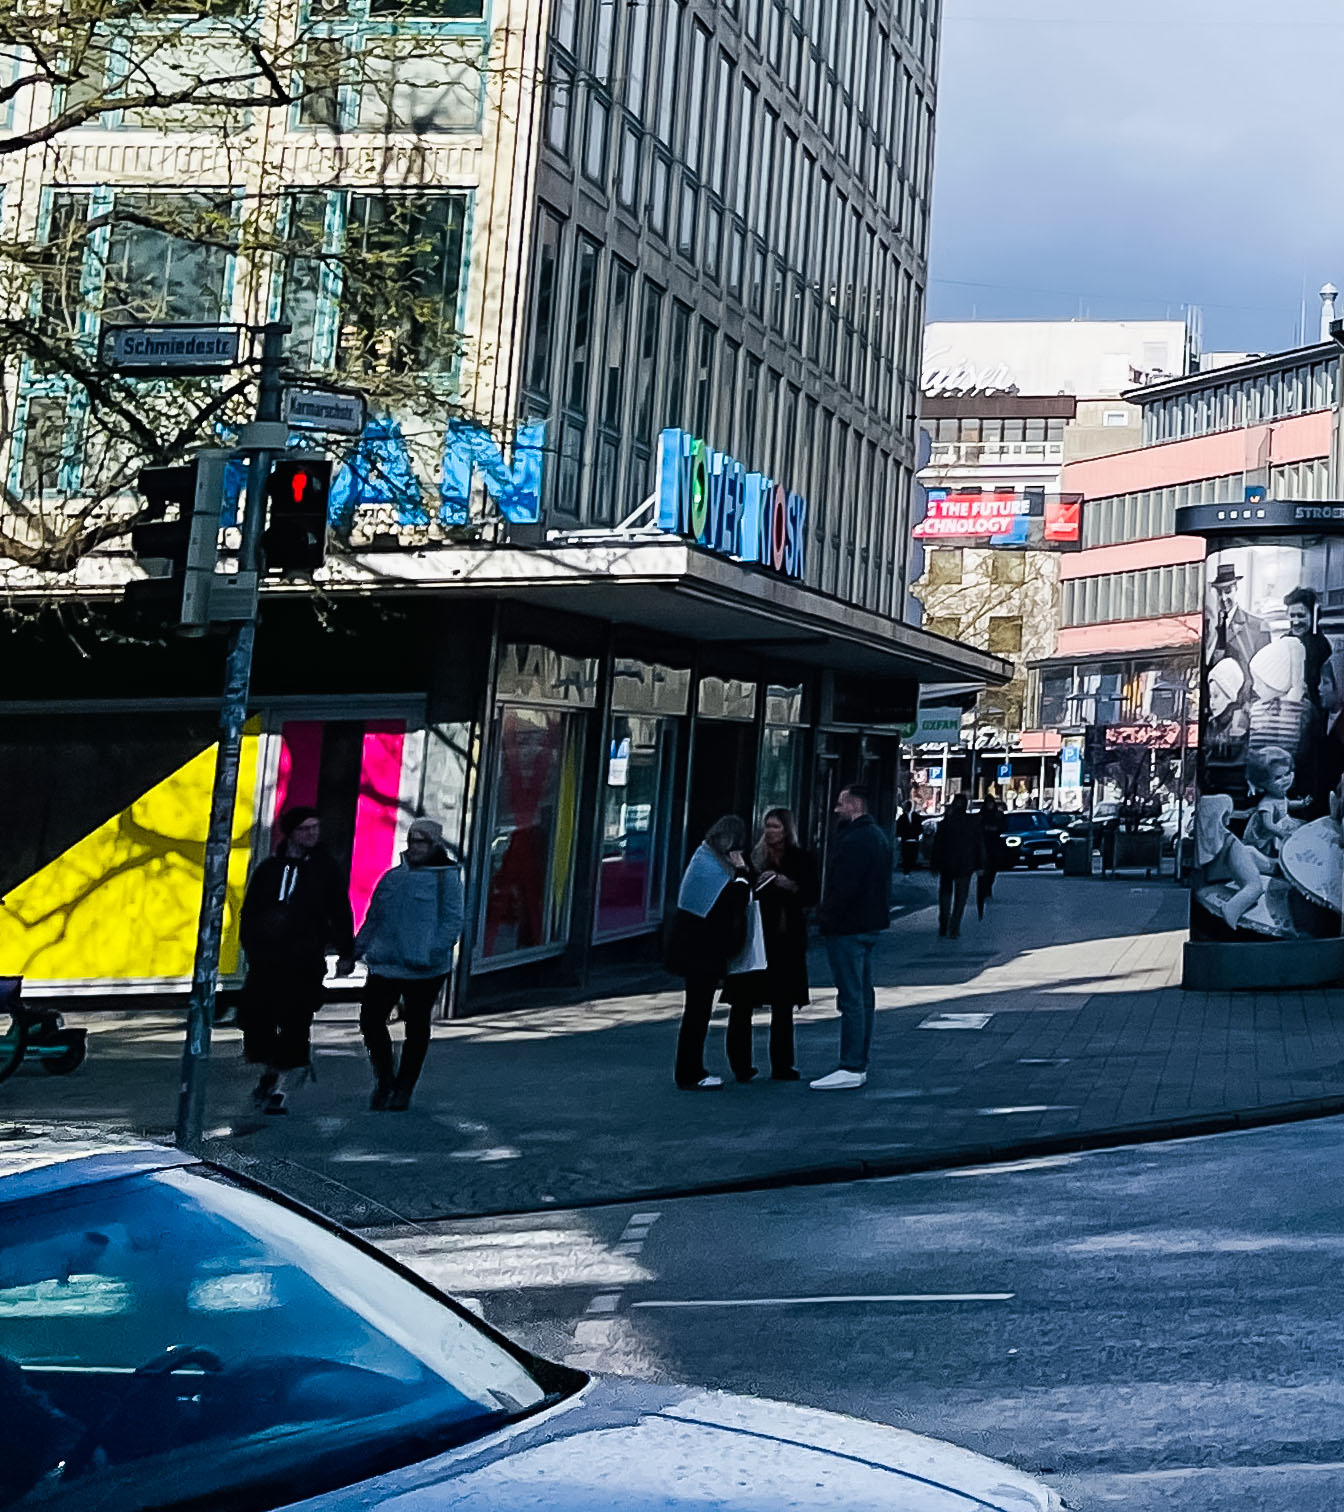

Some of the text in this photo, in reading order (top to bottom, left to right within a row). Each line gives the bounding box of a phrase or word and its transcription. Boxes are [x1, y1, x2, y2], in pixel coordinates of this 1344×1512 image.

[940, 501, 970, 517] THE
[971, 499, 1031, 517] FUTURE
[1000, 765, 1009, 776] P
